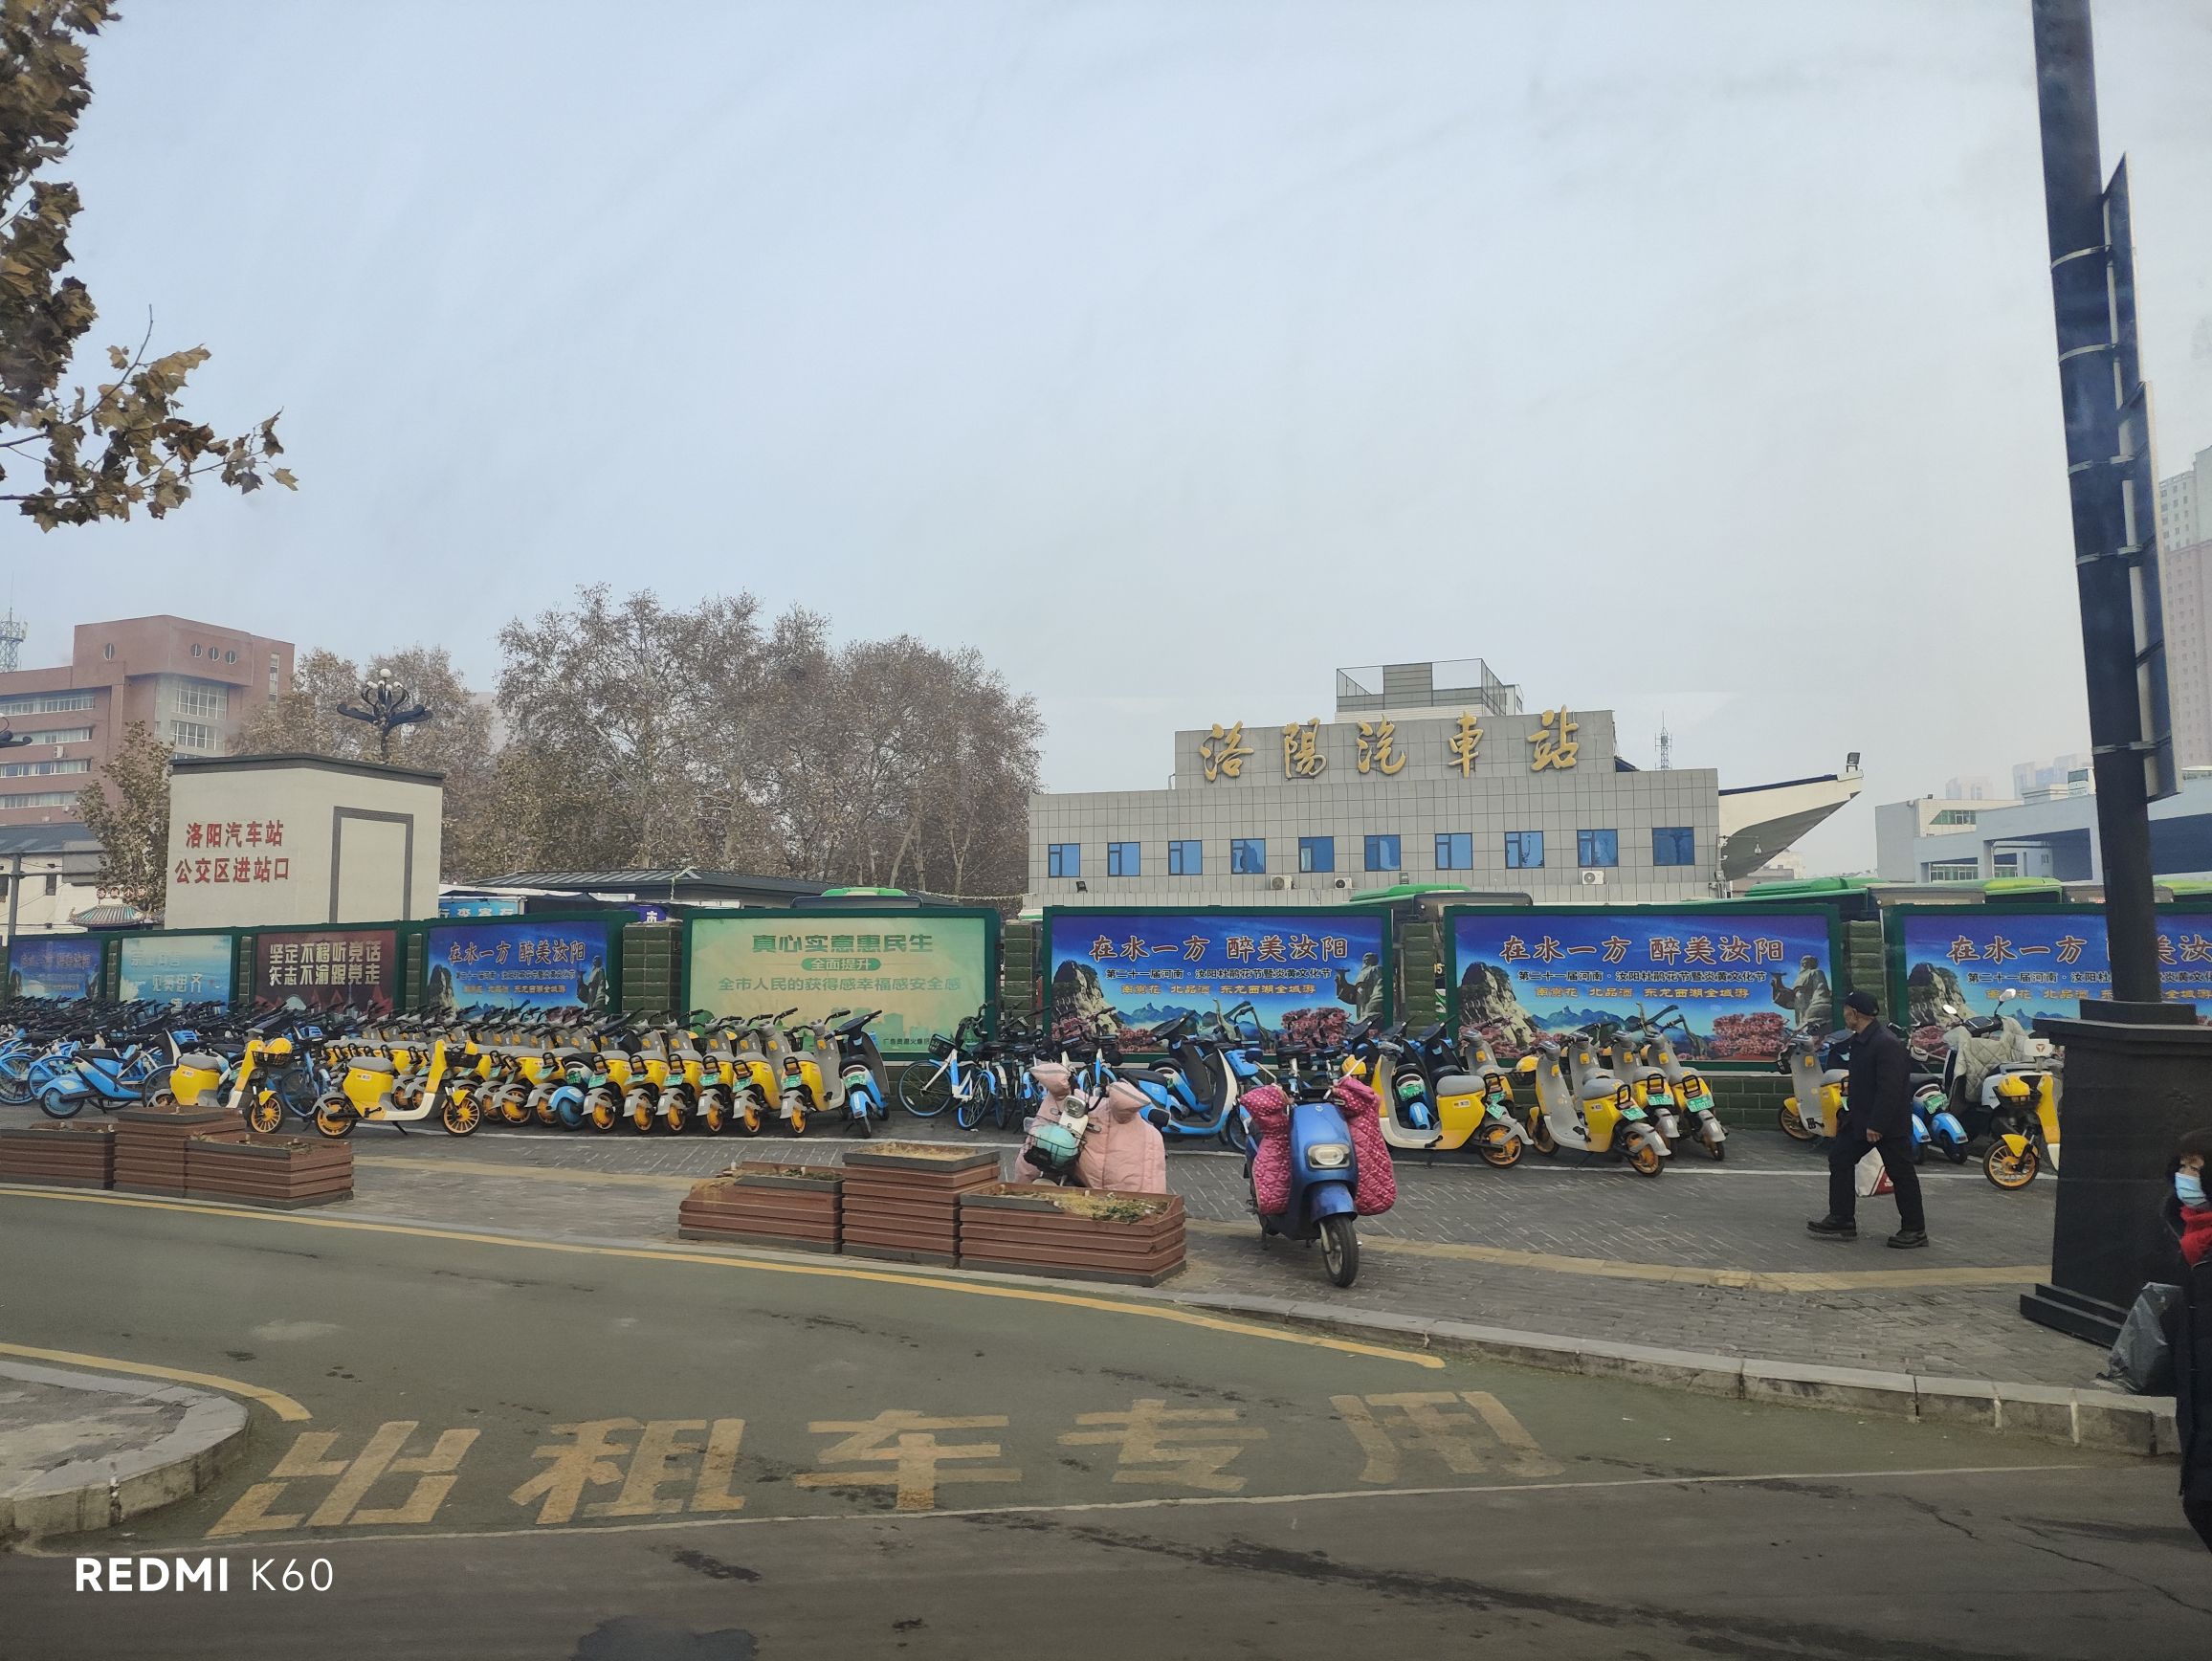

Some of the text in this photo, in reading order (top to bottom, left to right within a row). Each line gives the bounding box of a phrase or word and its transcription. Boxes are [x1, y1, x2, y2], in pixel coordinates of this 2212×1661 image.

[186, 819, 284, 849] 洛阳汽车站
[174, 855, 290, 884] 公交区进站口
[269, 941, 382, 964] 坚定不移听党话
[448, 939, 586, 966] 在水一方 醉美汝阳
[751, 934, 934, 954] 真心实意惠民生
[1089, 934, 1349, 963] 在水一方 醉美汝阳
[1498, 935, 1785, 964] 在水一方 醉美汝阳
[1946, 934, 2088, 964] 在水一方
[269, 963, 381, 986] 矢志不渝跟党走
[810, 958, 872, 971] 全面提升
[719, 977, 962, 992] 全市人民的获得感幸福感安全感
[206, 1390, 1566, 1536] 出租车专用
